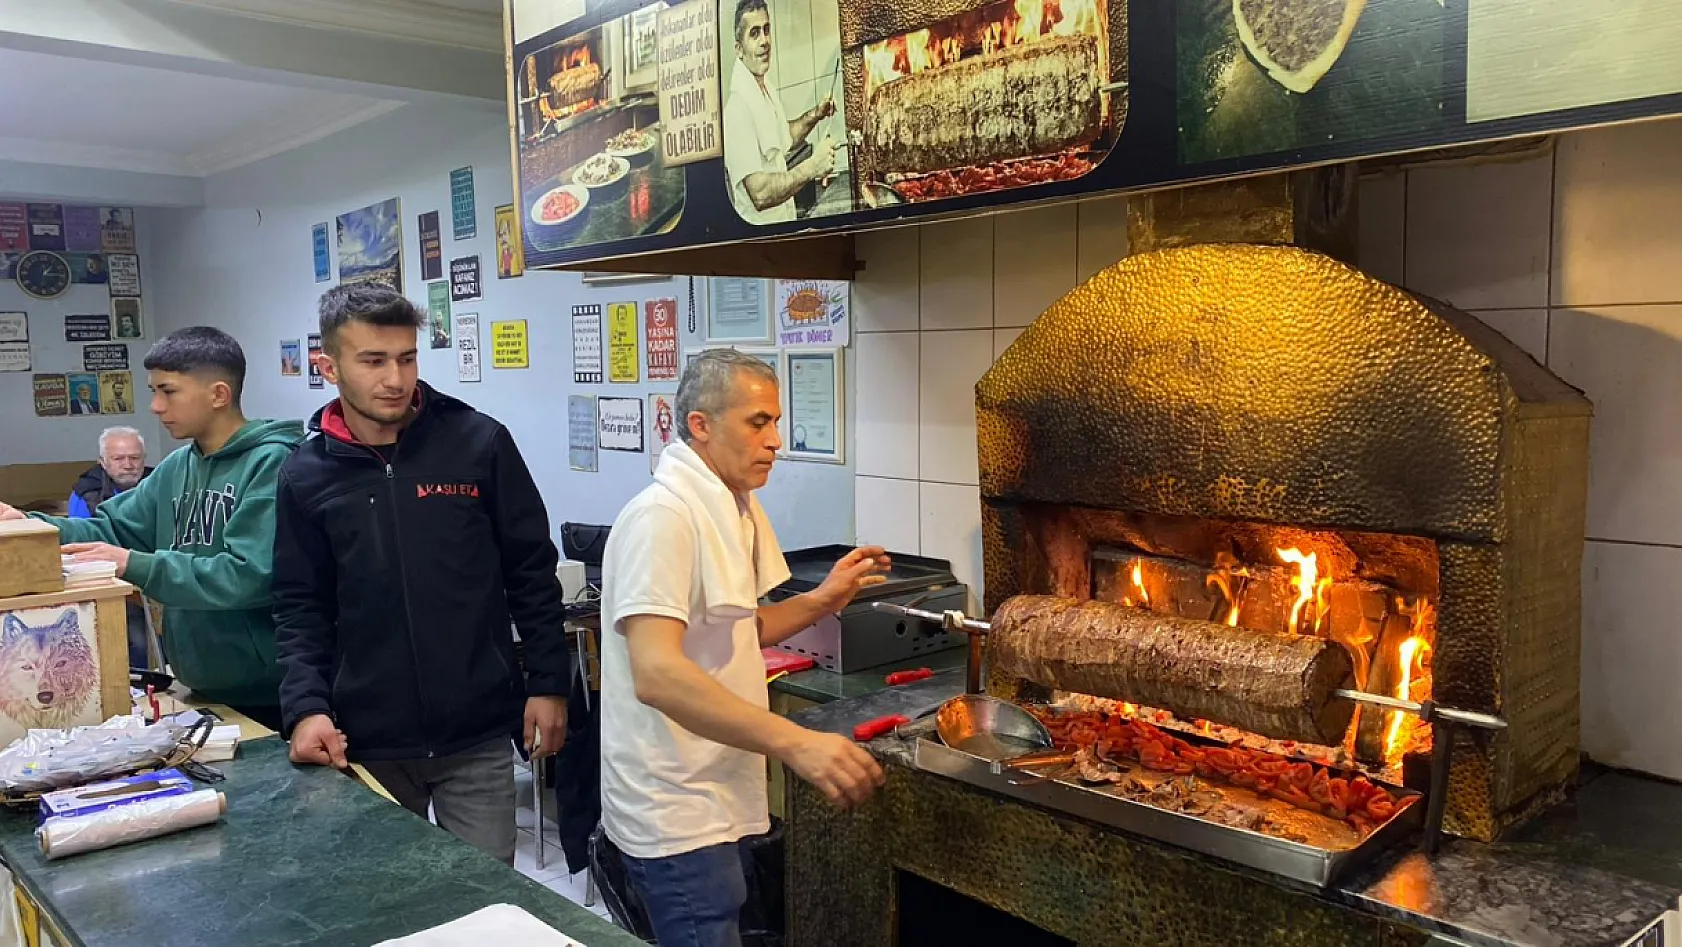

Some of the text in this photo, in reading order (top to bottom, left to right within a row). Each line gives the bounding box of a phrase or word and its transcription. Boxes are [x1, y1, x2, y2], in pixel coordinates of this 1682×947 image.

[670, 86, 706, 119] DEDİM
[666, 120, 715, 157] OLABİLİR
[648, 327, 675, 339] YAŞINA
[807, 329, 833, 342] DÖNER
[648, 340, 675, 352] KADAR
